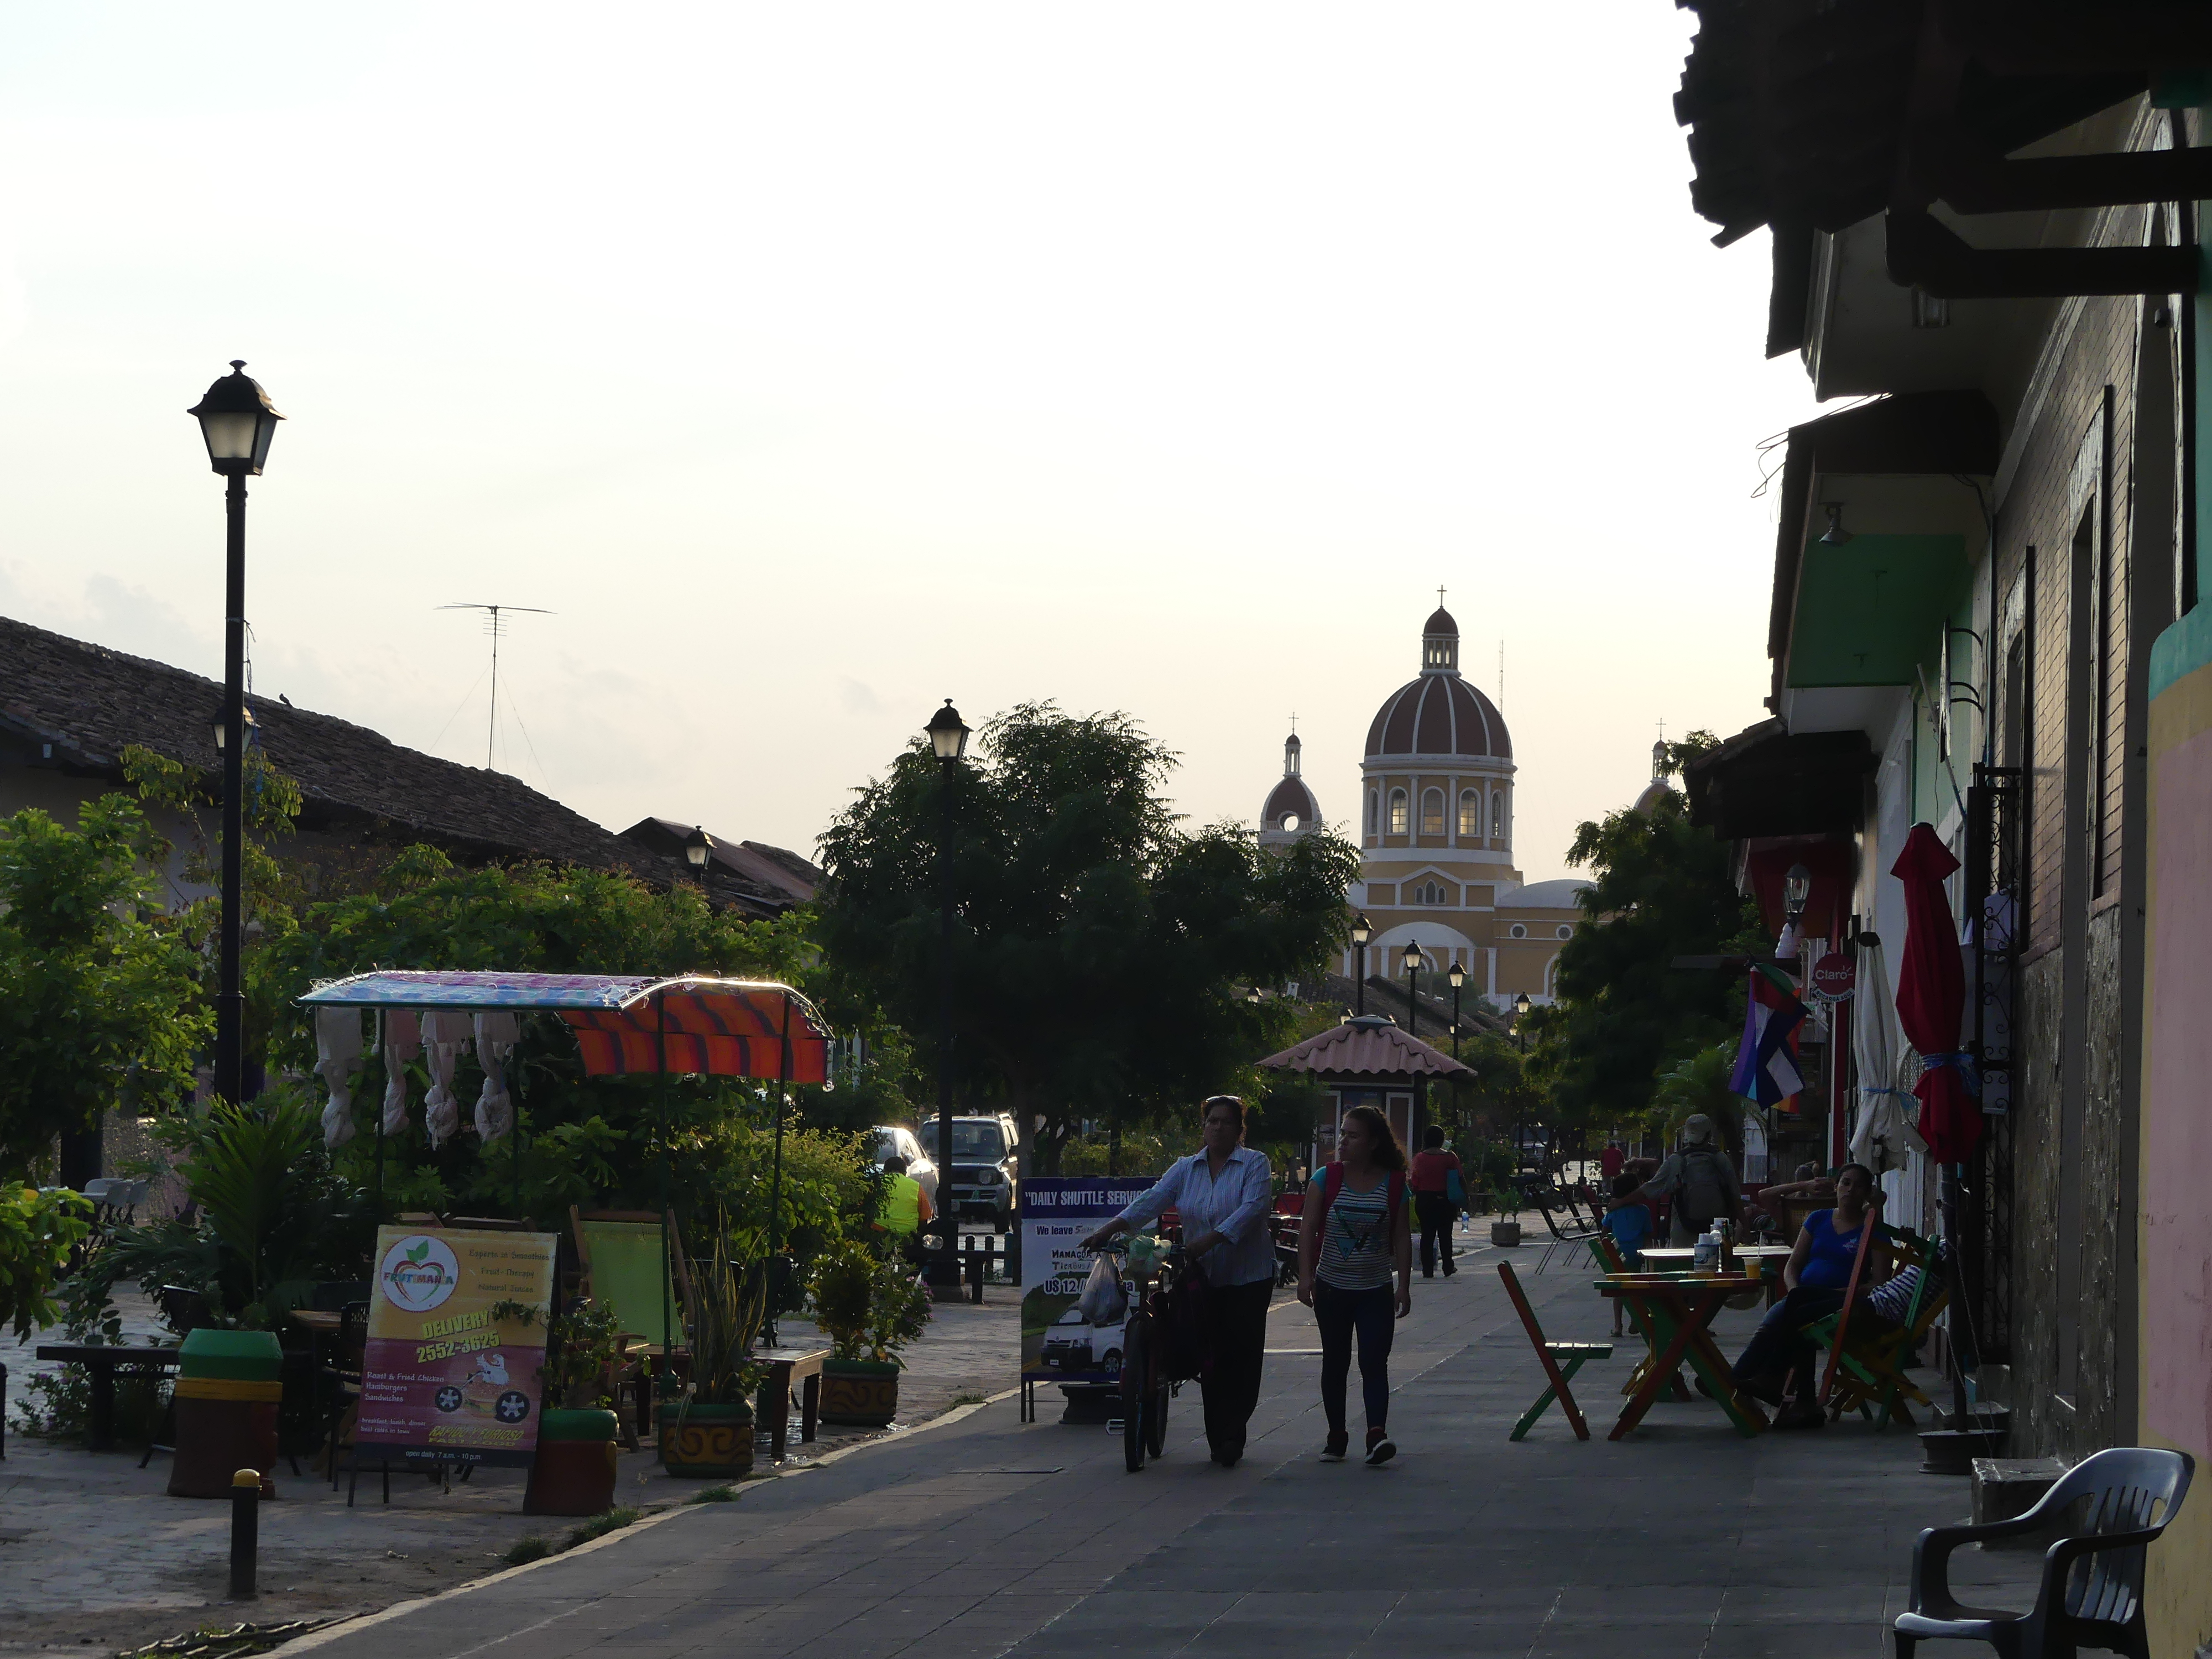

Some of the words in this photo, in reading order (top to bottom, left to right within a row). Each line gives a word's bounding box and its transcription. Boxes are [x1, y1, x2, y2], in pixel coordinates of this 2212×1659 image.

[1815, 969, 1848, 980] Claro
[1061, 1191, 1104, 1205] SHUTTLE
[1037, 1226, 1048, 1235] We
[1051, 1225, 1073, 1235] leave
[469, 1249, 498, 1259] Experts
[512, 1251, 549, 1260] Smoothies
[1052, 1249, 1092, 1259] MANAGUA
[1045, 1280, 1059, 1292] US
[1063, 1280, 1076, 1292] 12
[422, 1310, 489, 1339] DELIVERY
[416, 1329, 500, 1364] 2552-3625
[367, 1371, 387, 1380] Roast
[418, 1374, 445, 1383] Chicken
[366, 1382, 408, 1393] Hamburgers
[364, 1392, 404, 1402] Sandwiches
[479, 1428, 525, 1441] FURIOSO
